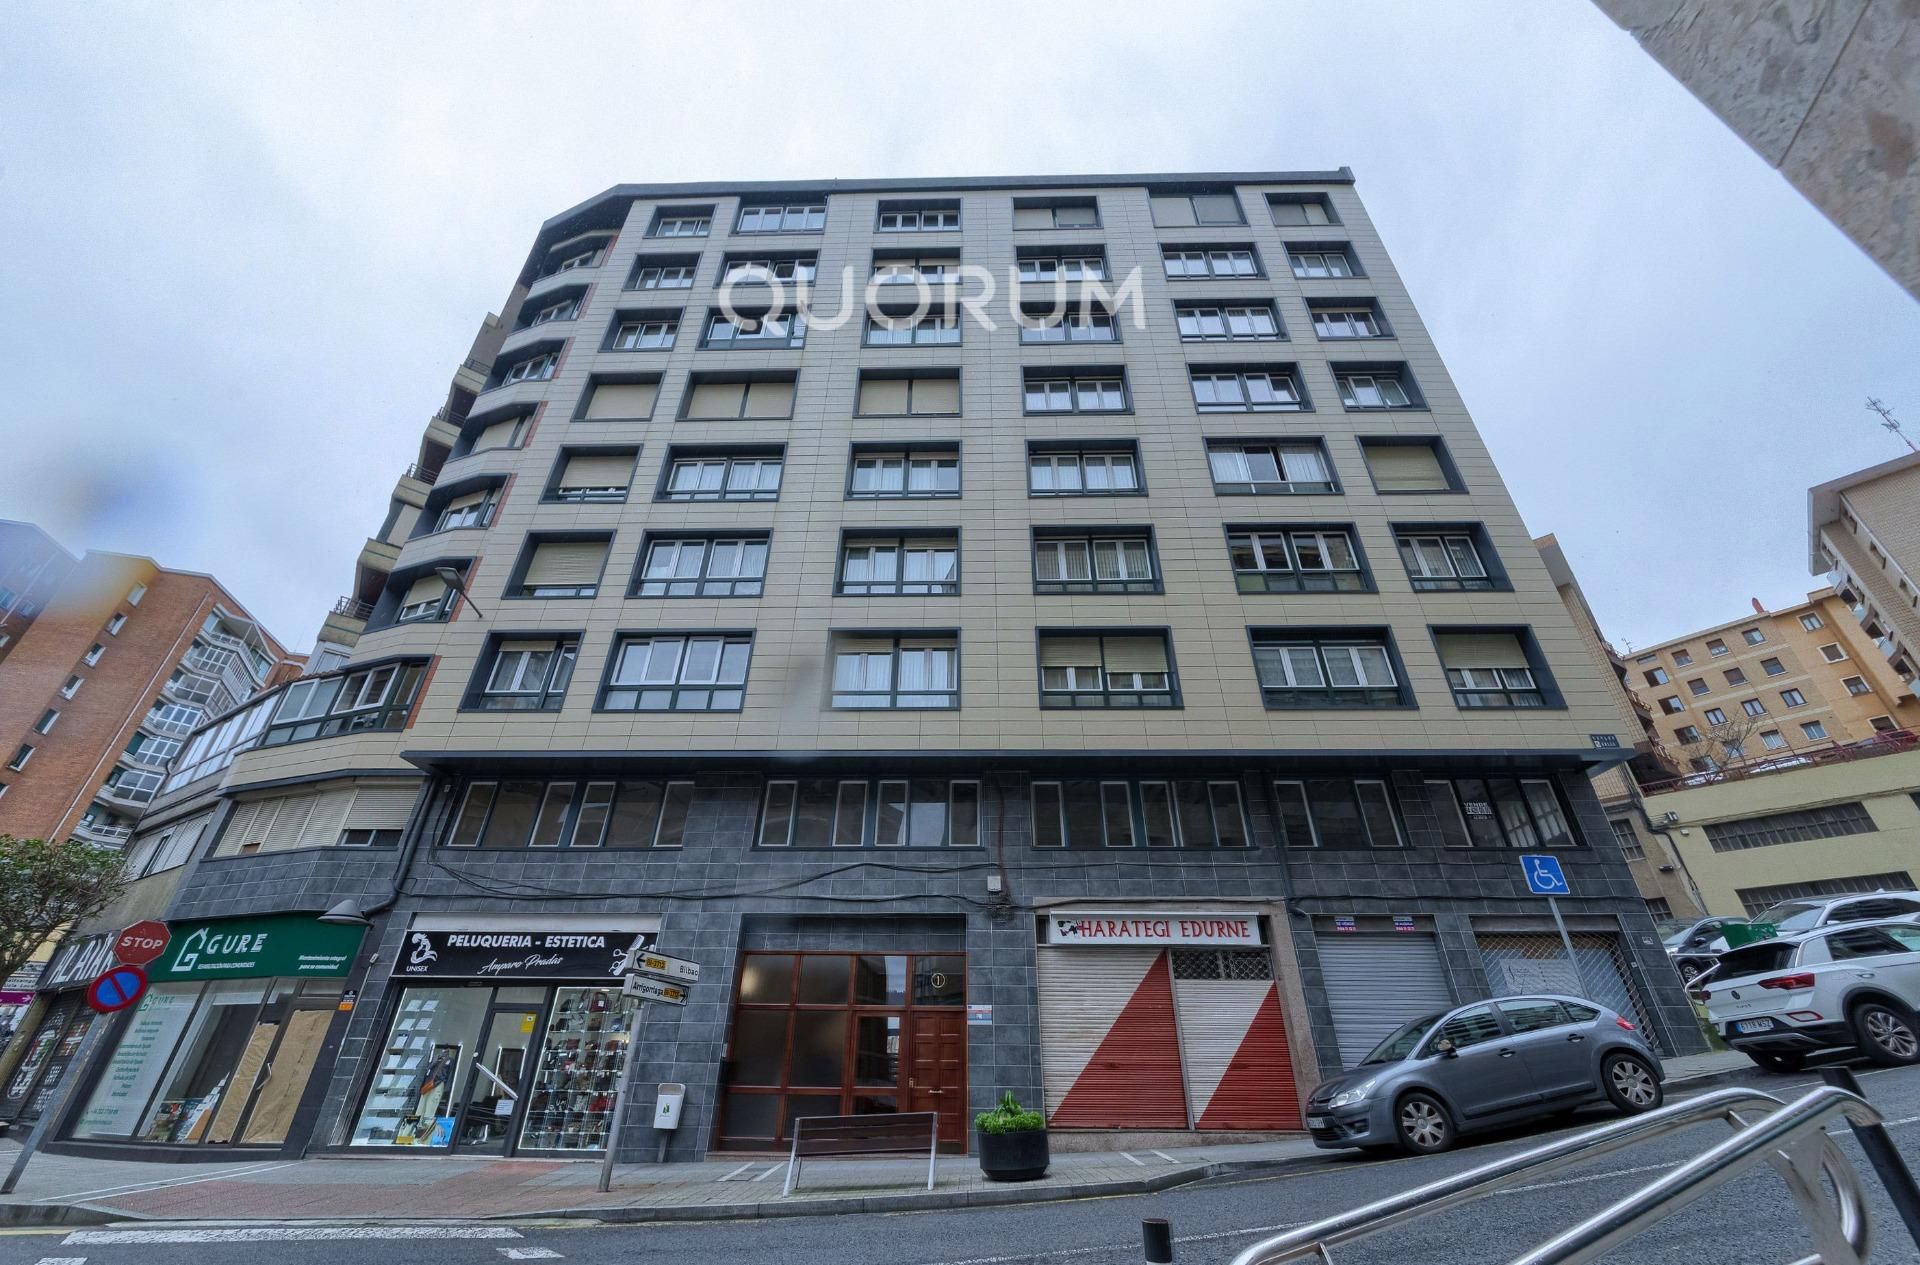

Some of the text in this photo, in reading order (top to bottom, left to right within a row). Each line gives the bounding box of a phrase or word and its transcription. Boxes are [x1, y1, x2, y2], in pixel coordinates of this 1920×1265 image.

[1081, 920, 1251, 938] HARATEGI EDURNE
[121, 936, 163, 950] STOP
[206, 933, 268, 955] GURE
[447, 934, 532, 948] PELUQUERIA
[545, 935, 605, 948] ESTETICA
[406, 965, 428, 973] UNISEX
[680, 965, 698, 976] Bilbao
[632, 981, 664, 997] Arrigorriaga
